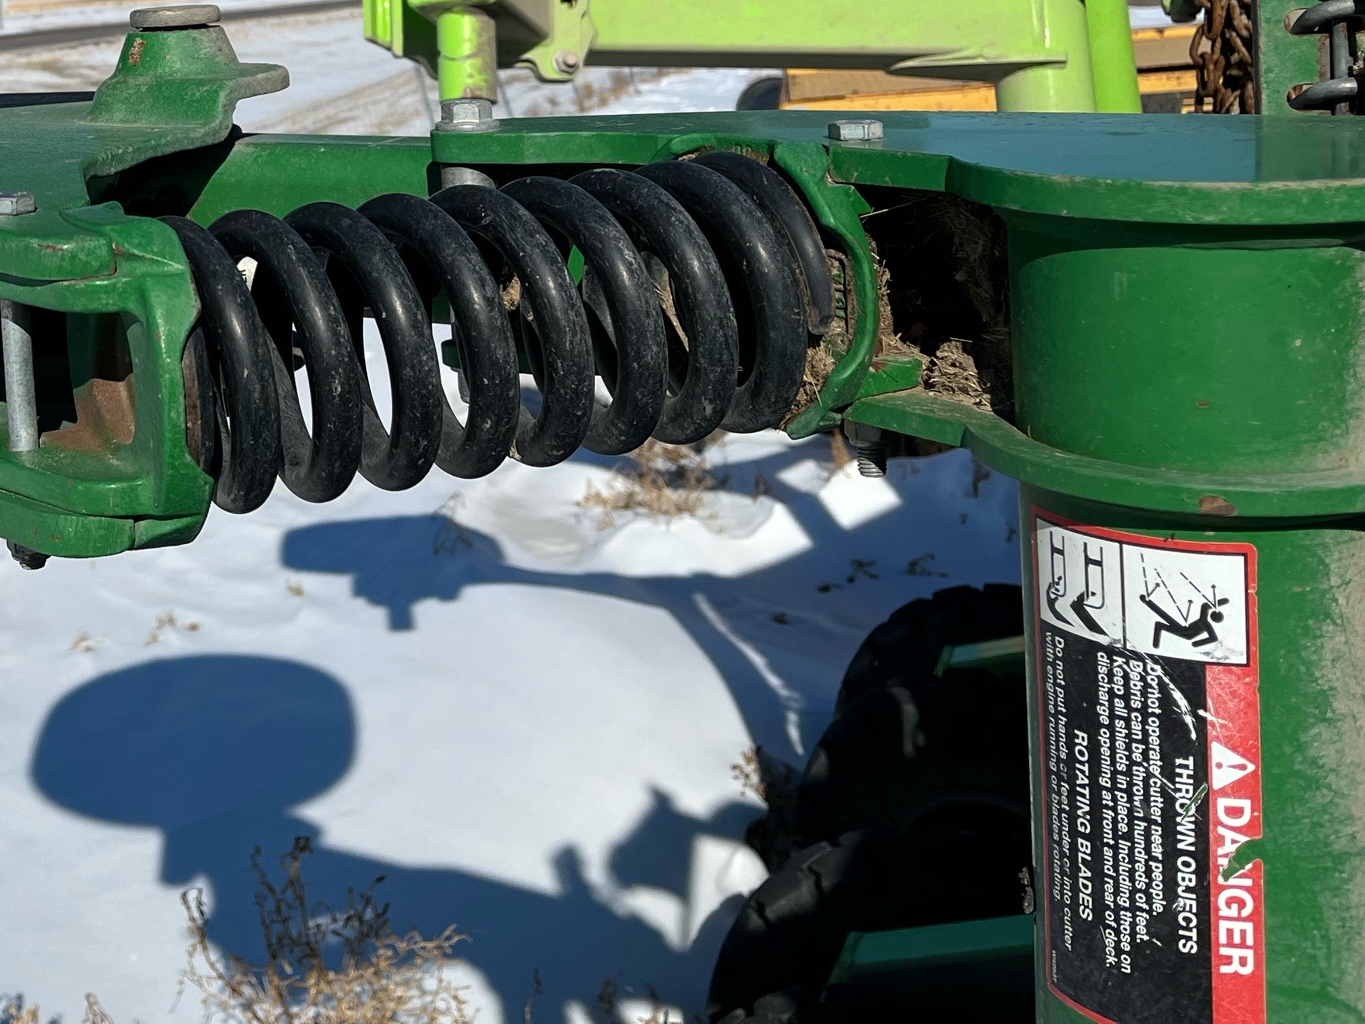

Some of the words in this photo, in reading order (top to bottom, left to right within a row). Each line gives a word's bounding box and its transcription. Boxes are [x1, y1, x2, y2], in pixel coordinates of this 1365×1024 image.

[1045, 632, 1054, 662] with
[1055, 636, 1064, 657] Do
[1046, 665, 1055, 713] engine
[1056, 660, 1065, 685] not
[1096, 652, 1110, 725] discharge
[1112, 656, 1126, 695] Keep
[1129, 660, 1144, 708] Debris
[1147, 662, 1161, 684] Do
[1056, 687, 1066, 712] put
[1114, 698, 1128, 716] all
[1148, 689, 1162, 714] not
[1049, 717, 1058, 772] running
[1058, 715, 1068, 760] hands
[1115, 719, 1129, 772] shields
[1131, 713, 1142, 739] can
[1098, 728, 1113, 788] opening
[1132, 743, 1145, 762] be
[1146, 719, 1163, 774] operate
[1051, 775, 1058, 792] or
[1061, 781, 1069, 810] feet
[1074, 729, 1090, 834] ROTATING
[1101, 790, 1114, 807] at
[1116, 775, 1129, 789] in
[1132, 766, 1146, 817] thrown
[1149, 778, 1163, 823] cutter
[1052, 794, 1060, 841] blades
[1115, 791, 1130, 835] place.
[1175, 756, 1196, 851] THROWN
[1062, 813, 1071, 856] under
[1102, 809, 1114, 845] front
[1151, 825, 1163, 860] near
[1053, 844, 1062, 901] rotating.
[1062, 858, 1070, 875] or
[1103, 846, 1116, 876] and
[1117, 840, 1132, 907] Including
[1134, 820, 1148, 890] hundreds
[1063, 876, 1072, 904] into
[1077, 838, 1092, 921] BLADES
[1104, 878, 1114, 909] rear
[1149, 861, 1166, 915] people.
[1104, 911, 1117, 928] of
[1135, 893, 1149, 910] of
[1177, 856, 1198, 954] OBJECTS
[1064, 907, 1073, 951] cutter
[1119, 911, 1132, 951] those
[1136, 911, 1149, 943] feet.
[1105, 928, 1118, 967] deck.
[1120, 954, 1131, 974] on
